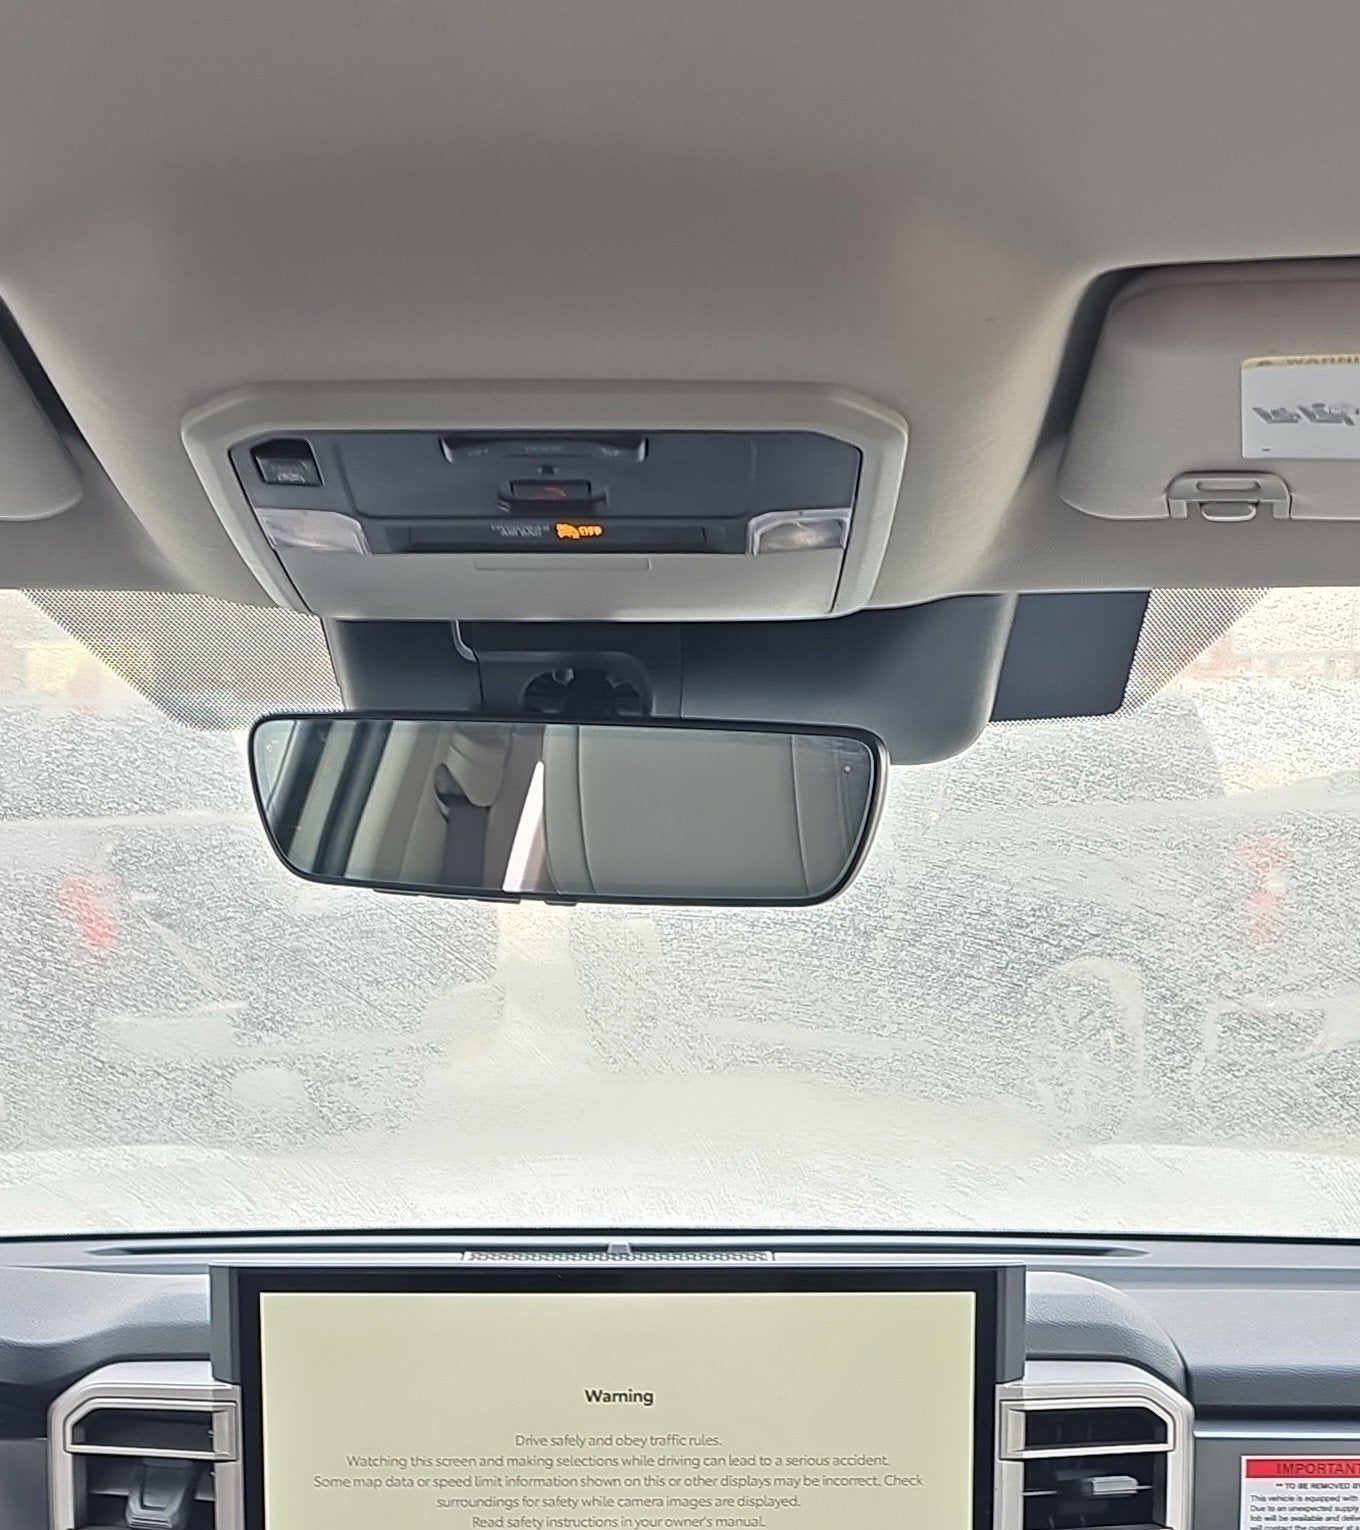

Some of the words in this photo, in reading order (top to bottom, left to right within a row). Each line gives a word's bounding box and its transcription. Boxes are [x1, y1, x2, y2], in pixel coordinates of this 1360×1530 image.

[585, 1388, 654, 1406] Warning
[515, 1434, 548, 1446] Drive
[551, 1434, 586, 1448] safely
[589, 1434, 612, 1446] and
[615, 1434, 647, 1448] obey
[650, 1434, 686, 1446] traffic
[689, 1434, 722, 1446] rules.
[346, 1455, 407, 1469] Watching
[410, 1455, 433, 1467] this
[435, 1457, 477, 1467] screen
[479, 1455, 503, 1467] and
[507, 1455, 554, 1469] making
[556, 1455, 619, 1467] selections
[622, 1455, 655, 1467] while
[657, 1455, 700, 1469] driving
[703, 1457, 725, 1467] can
[728, 1455, 756, 1467] lead
[759, 1455, 773, 1467] to
[775, 1457, 783, 1467] a
[785, 1455, 830, 1467] serious
[832, 1455, 889, 1467] accident.
[313, 1475, 352, 1487] Some
[353, 1478, 382, 1490] map
[386, 1475, 414, 1487] data
[417, 1478, 431, 1488] or
[433, 1475, 472, 1490] speed
[474, 1475, 502, 1487] limit
[505, 1475, 578, 1487] information
[580, 1475, 622, 1487] shown
[624, 1478, 641, 1487] on
[643, 1475, 666, 1487] this
[668, 1478, 682, 1487] or
[684, 1475, 718, 1487] other
[720, 1474, 771, 1489] displays
[773, 1477, 801, 1489] may
[803, 1475, 819, 1487] be
[822, 1475, 881, 1487] incorrect.
[883, 1475, 923, 1487] Check
[437, 1496, 519, 1510] surroundings
[522, 1496, 540, 1508] for
[542, 1496, 579, 1510] safety
[581, 1496, 615, 1508] while
[618, 1498, 664, 1508] camera
[666, 1496, 712, 1510] images
[714, 1498, 735, 1508] are
[737, 1496, 801, 1510] displayed.
[472, 1516, 503, 1528] Read
[507, 1516, 543, 1530] safety
[546, 1516, 618, 1528] instructions
[621, 1516, 632, 1528] in
[634, 1518, 662, 1530] your
[665, 1516, 713, 1528] owner's
[716, 1516, 766, 1528] manual.
